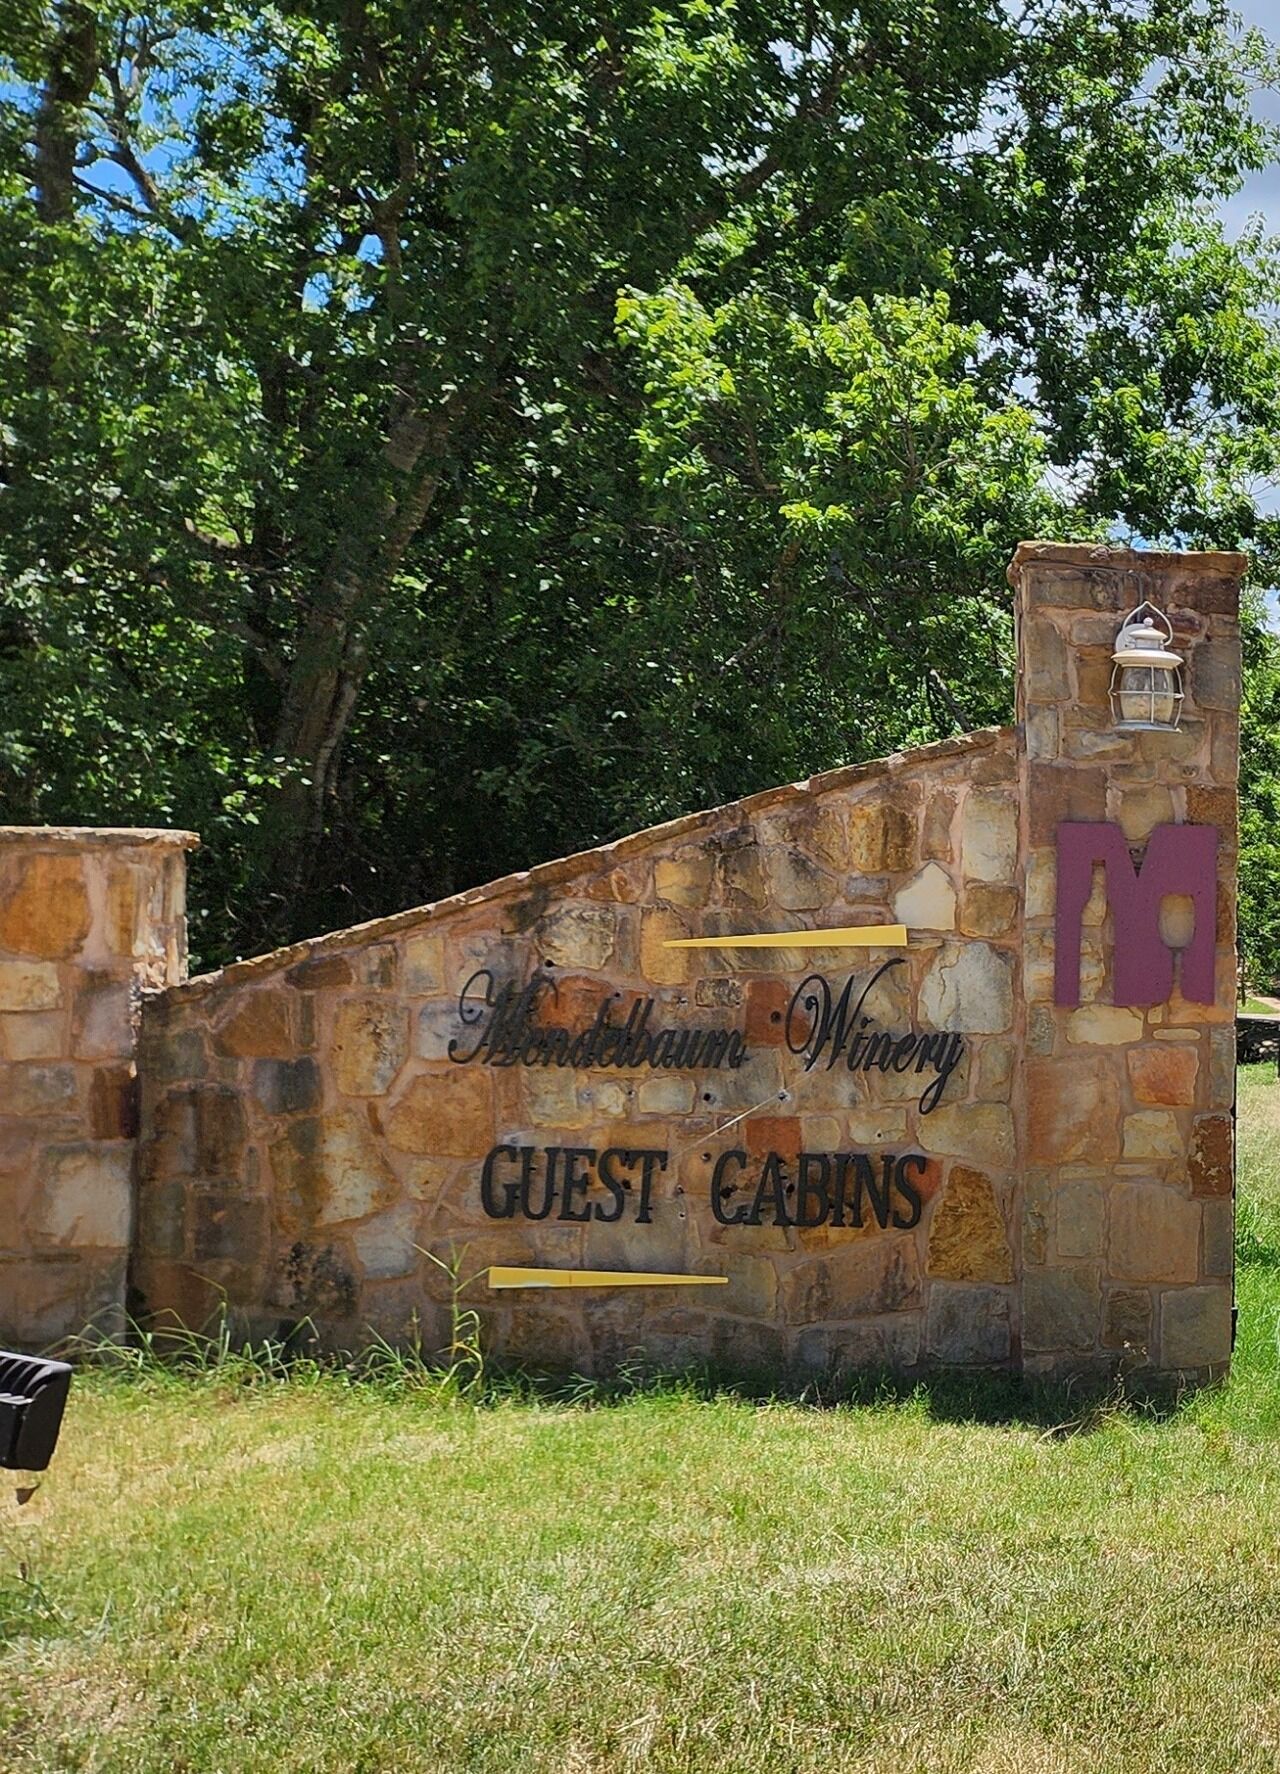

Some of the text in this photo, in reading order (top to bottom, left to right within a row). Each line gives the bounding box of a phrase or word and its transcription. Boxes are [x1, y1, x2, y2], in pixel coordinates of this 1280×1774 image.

[1055, 820, 1217, 1007] M
[785, 958, 964, 1115] Winery
[480, 1143, 927, 1230] GUEST CABINS
